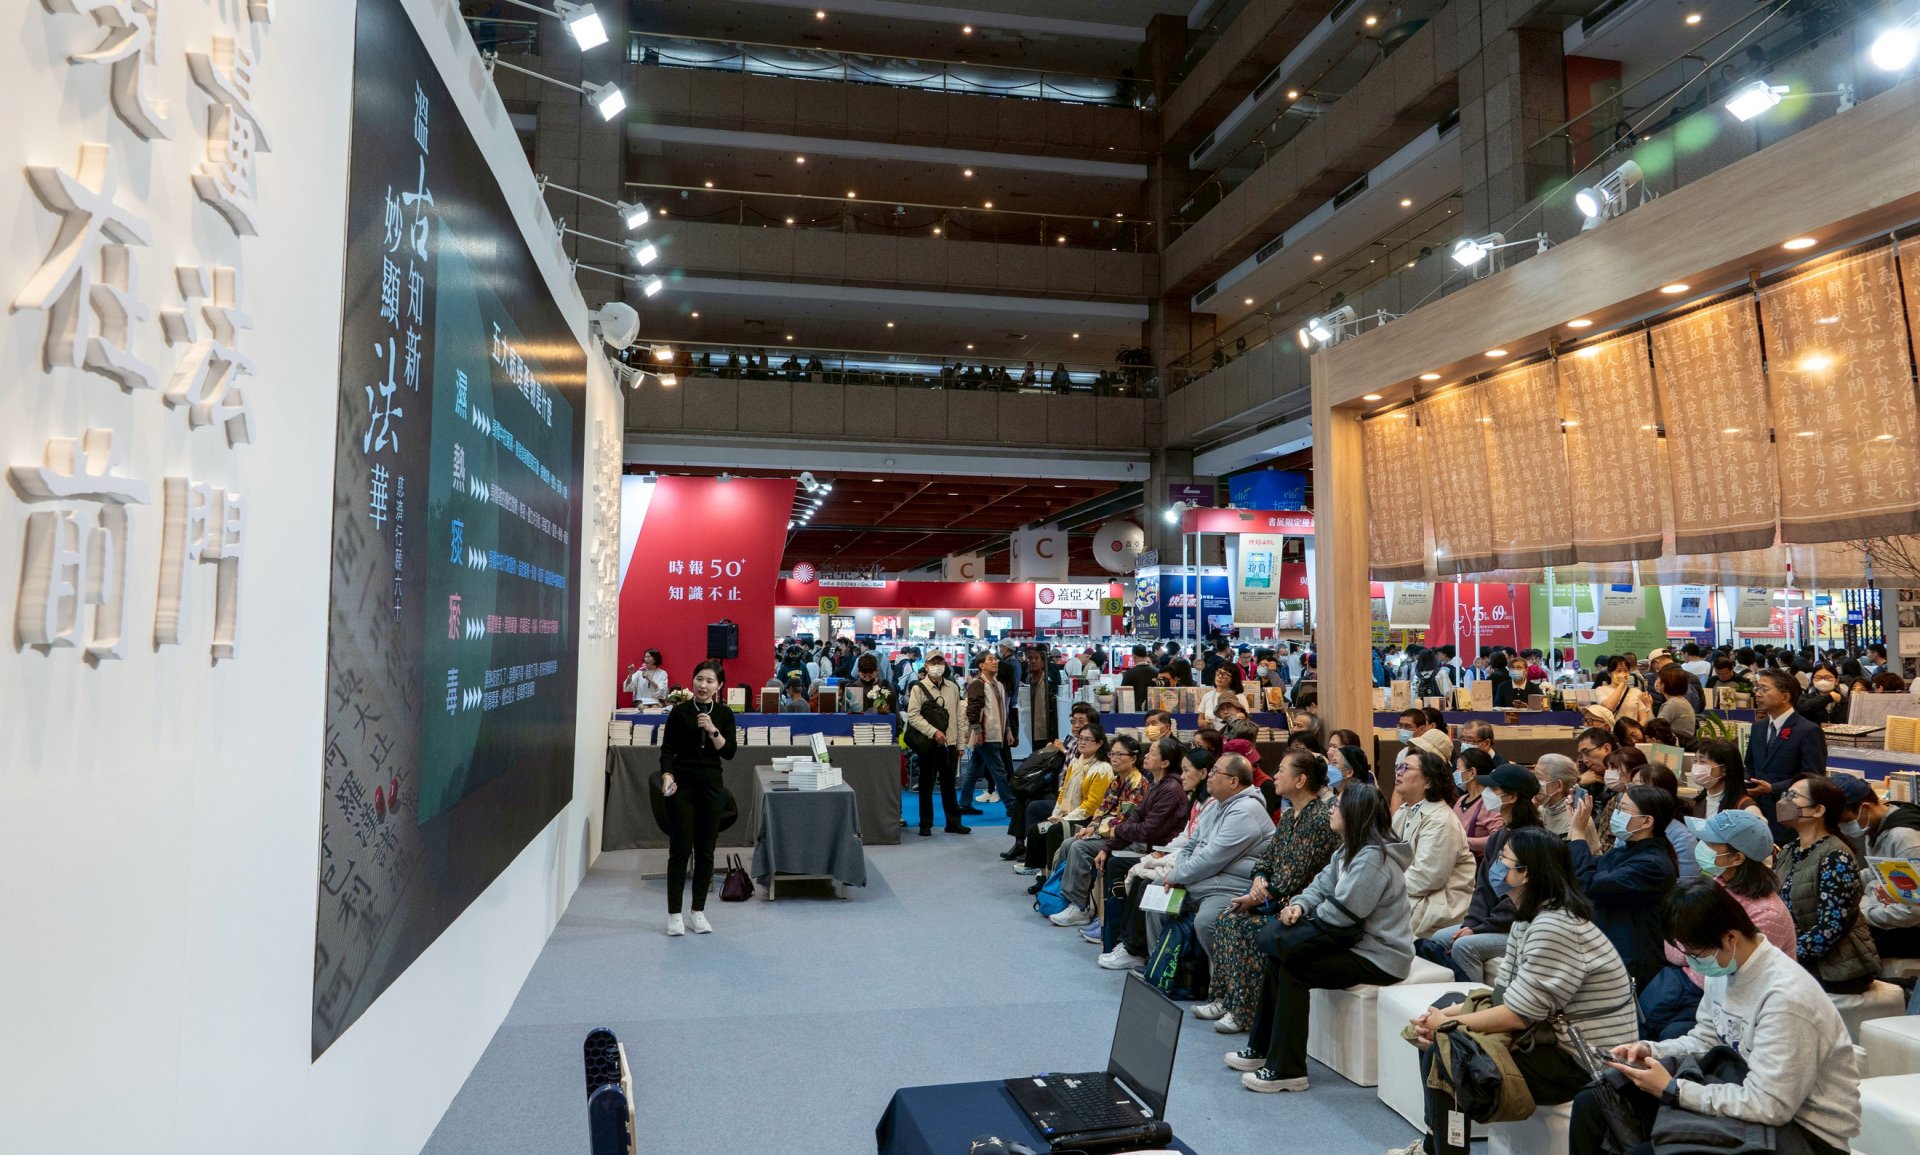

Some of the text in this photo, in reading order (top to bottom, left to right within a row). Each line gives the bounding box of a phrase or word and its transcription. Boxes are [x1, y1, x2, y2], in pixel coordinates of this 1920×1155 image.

[155, 0, 275, 666] 量法門
[450, 518, 464, 566] 痰
[1036, 538, 1054, 558] C
[668, 560, 704, 575] 時報
[960, 563, 974, 579] C
[668, 586, 742, 601] 知識不止
[1057, 588, 1106, 601] 蓋亞文化
[445, 668, 459, 716] 毒
